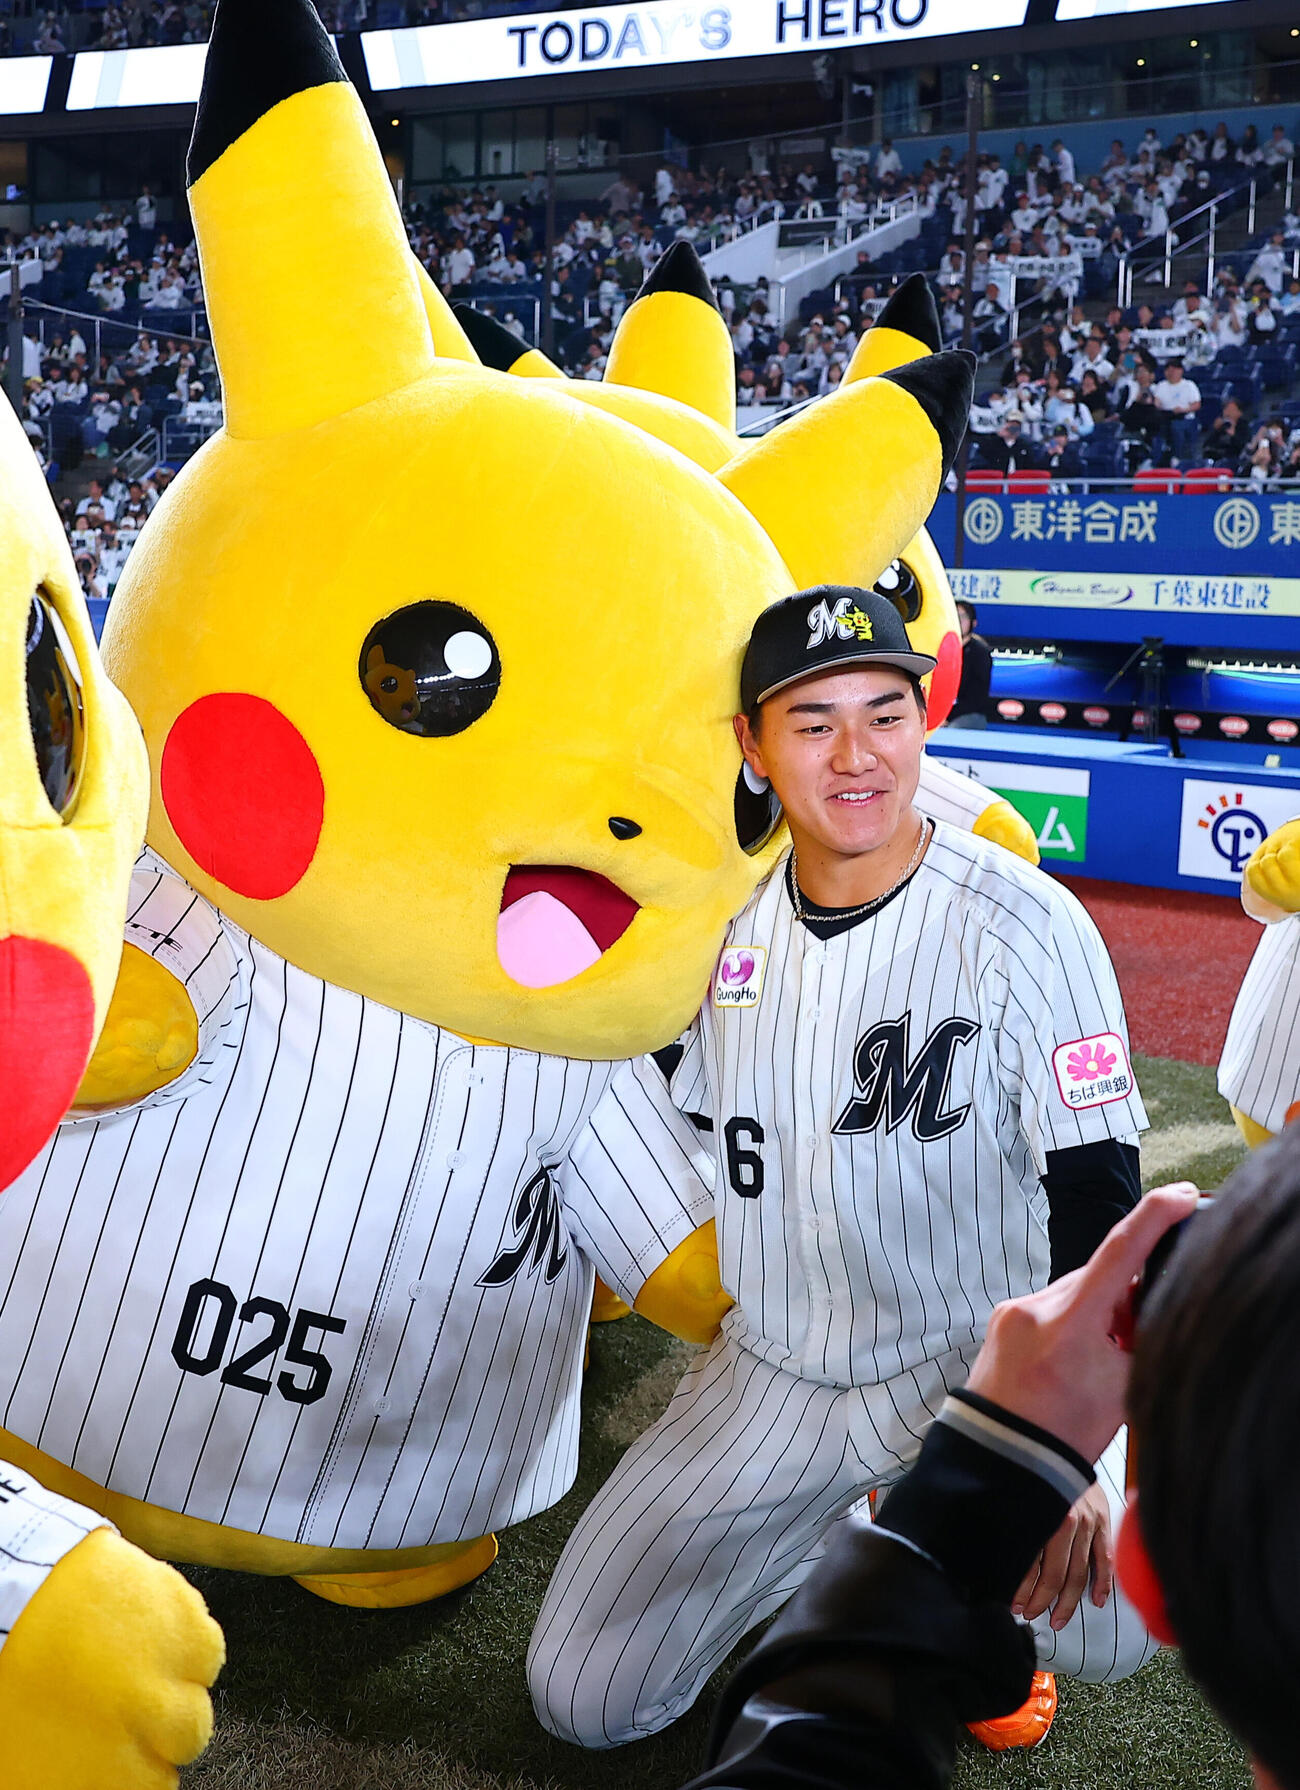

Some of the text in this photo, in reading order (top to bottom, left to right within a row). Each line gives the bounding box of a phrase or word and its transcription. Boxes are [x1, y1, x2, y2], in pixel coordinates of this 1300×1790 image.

[775, 0, 929, 44] HERO
[1010, 499, 1159, 543] 東洋合成
[1150, 579, 1272, 610] 千葉東建設
[716, 986, 757, 1003] GungHo
[831, 1010, 982, 1143] M
[1067, 1075, 1129, 1104] ちば興銀
[724, 1116, 765, 1200] 6
[171, 1277, 348, 1406] 025
